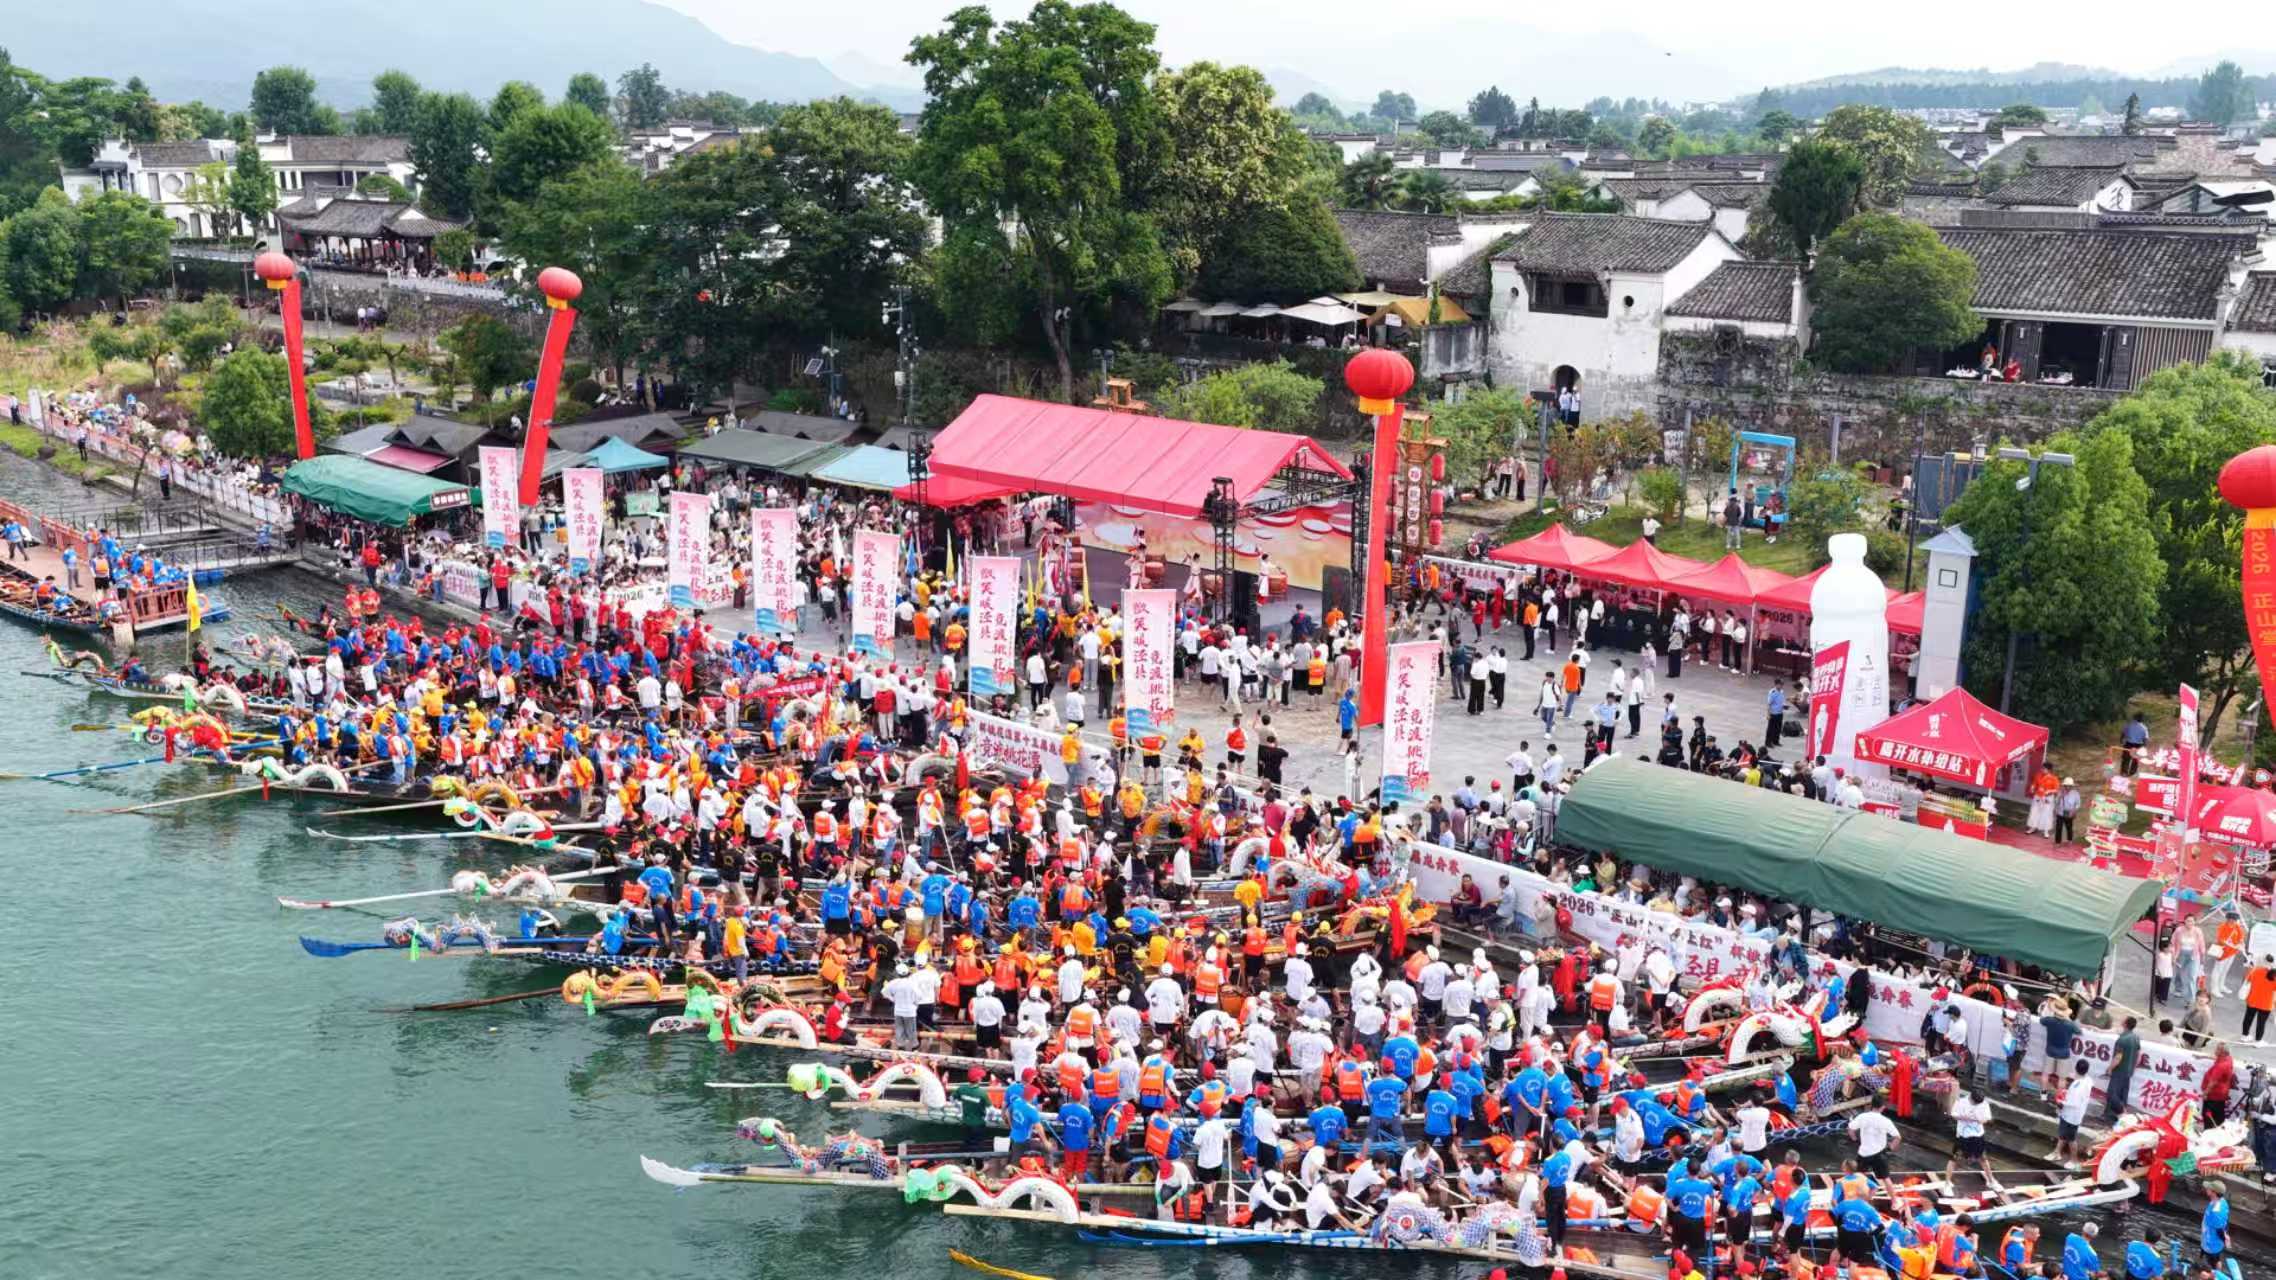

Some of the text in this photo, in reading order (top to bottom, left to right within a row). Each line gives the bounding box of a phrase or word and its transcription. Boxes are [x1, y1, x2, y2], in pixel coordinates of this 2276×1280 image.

[1879, 741, 1964, 773] 喝开水补给站
[1559, 892, 1595, 917] 2026
[2070, 1036, 2112, 1061] 026
